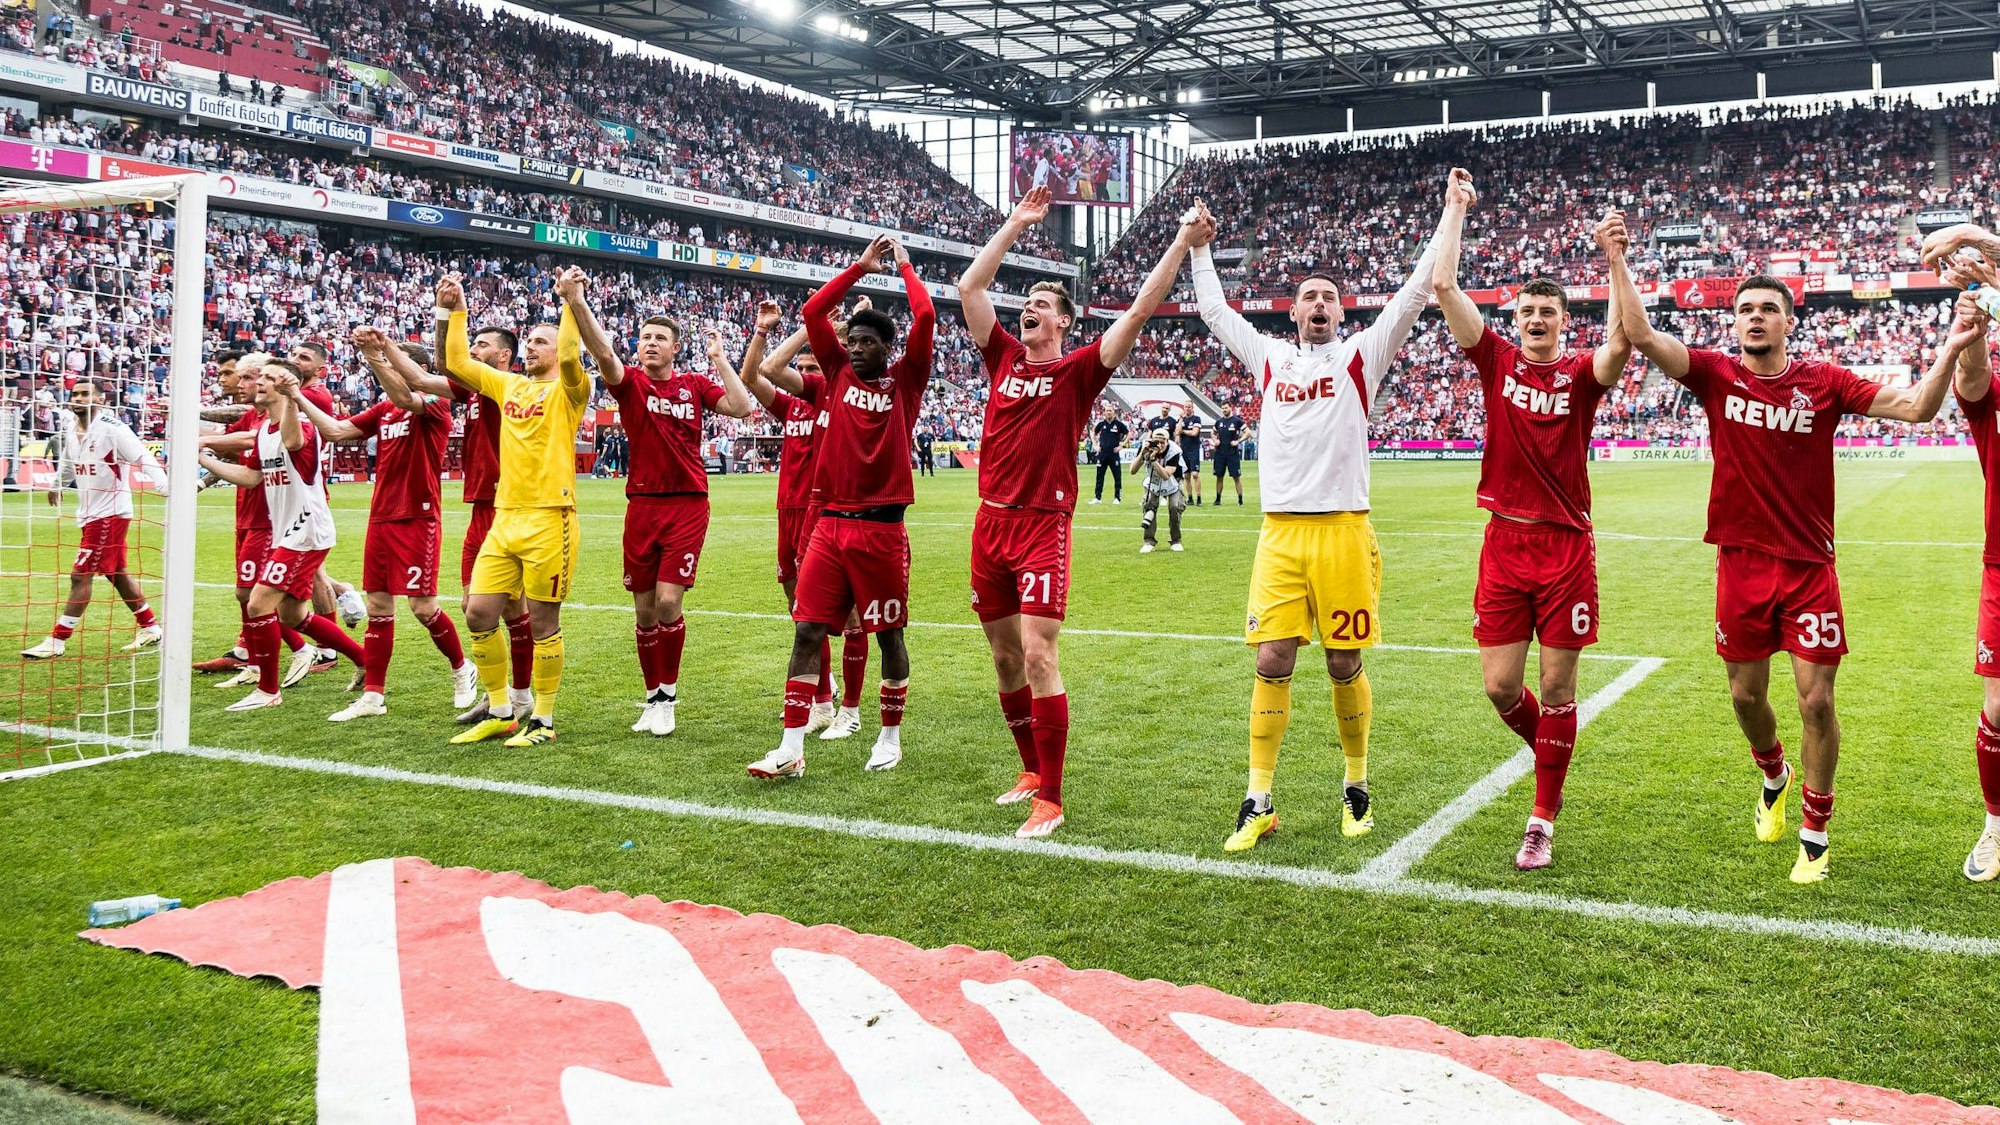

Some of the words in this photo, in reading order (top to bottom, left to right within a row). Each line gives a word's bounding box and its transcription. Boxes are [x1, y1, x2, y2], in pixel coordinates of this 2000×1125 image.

[91, 75, 187, 109] BAUWENS
[199, 97, 237, 118] Gaffel
[239, 104, 280, 127] Kölsch
[292, 115, 328, 136] Gaffel
[329, 121, 366, 144] Kölsch
[452, 146, 500, 163] LIEBHERR
[523, 158, 568, 176] X-PRINT.DE
[602, 176, 625, 188] seitz
[239, 184, 292, 200] RheinEnergie
[331, 197, 379, 213] RheinEnergie
[415, 209, 437, 222] Ford
[470, 218, 531, 234] BULLS
[546, 225, 589, 247] DEVK
[610, 235, 649, 250] SAUREN
[672, 244, 699, 262] HDI
[716, 253, 730, 265] SAP
[739, 256, 753, 269] SAP
[1356, 295, 1388, 307] REWE
[1567, 287, 1591, 299] EWE
[1179, 302, 1201, 313] REW
[1242, 300, 1273, 311] REWE
[1275, 377, 1335, 403] REWE
[1501, 375, 1571, 416] REWE
[503, 401, 544, 419] REWE
[647, 395, 695, 421] REWE
[1725, 394, 1815, 434] REWE
[380, 419, 410, 441] EWE
[786, 419, 814, 437] REW
[1369, 450, 1394, 459] ckerei
[1395, 450, 1438, 459] Schneider
[1632, 450, 1669, 460] STARK
[264, 470, 291, 487] EWE
[241, 560, 256, 582] 9
[262, 560, 288, 585] 18
[679, 552, 695, 578] 3
[407, 566, 423, 590] 2
[549, 573, 560, 598] 1
[1021, 571, 1051, 605] 21
[863, 599, 901, 626] 40
[1571, 601, 1591, 636] 6
[1331, 608, 1371, 641] 20
[1796, 611, 1841, 649] 35
